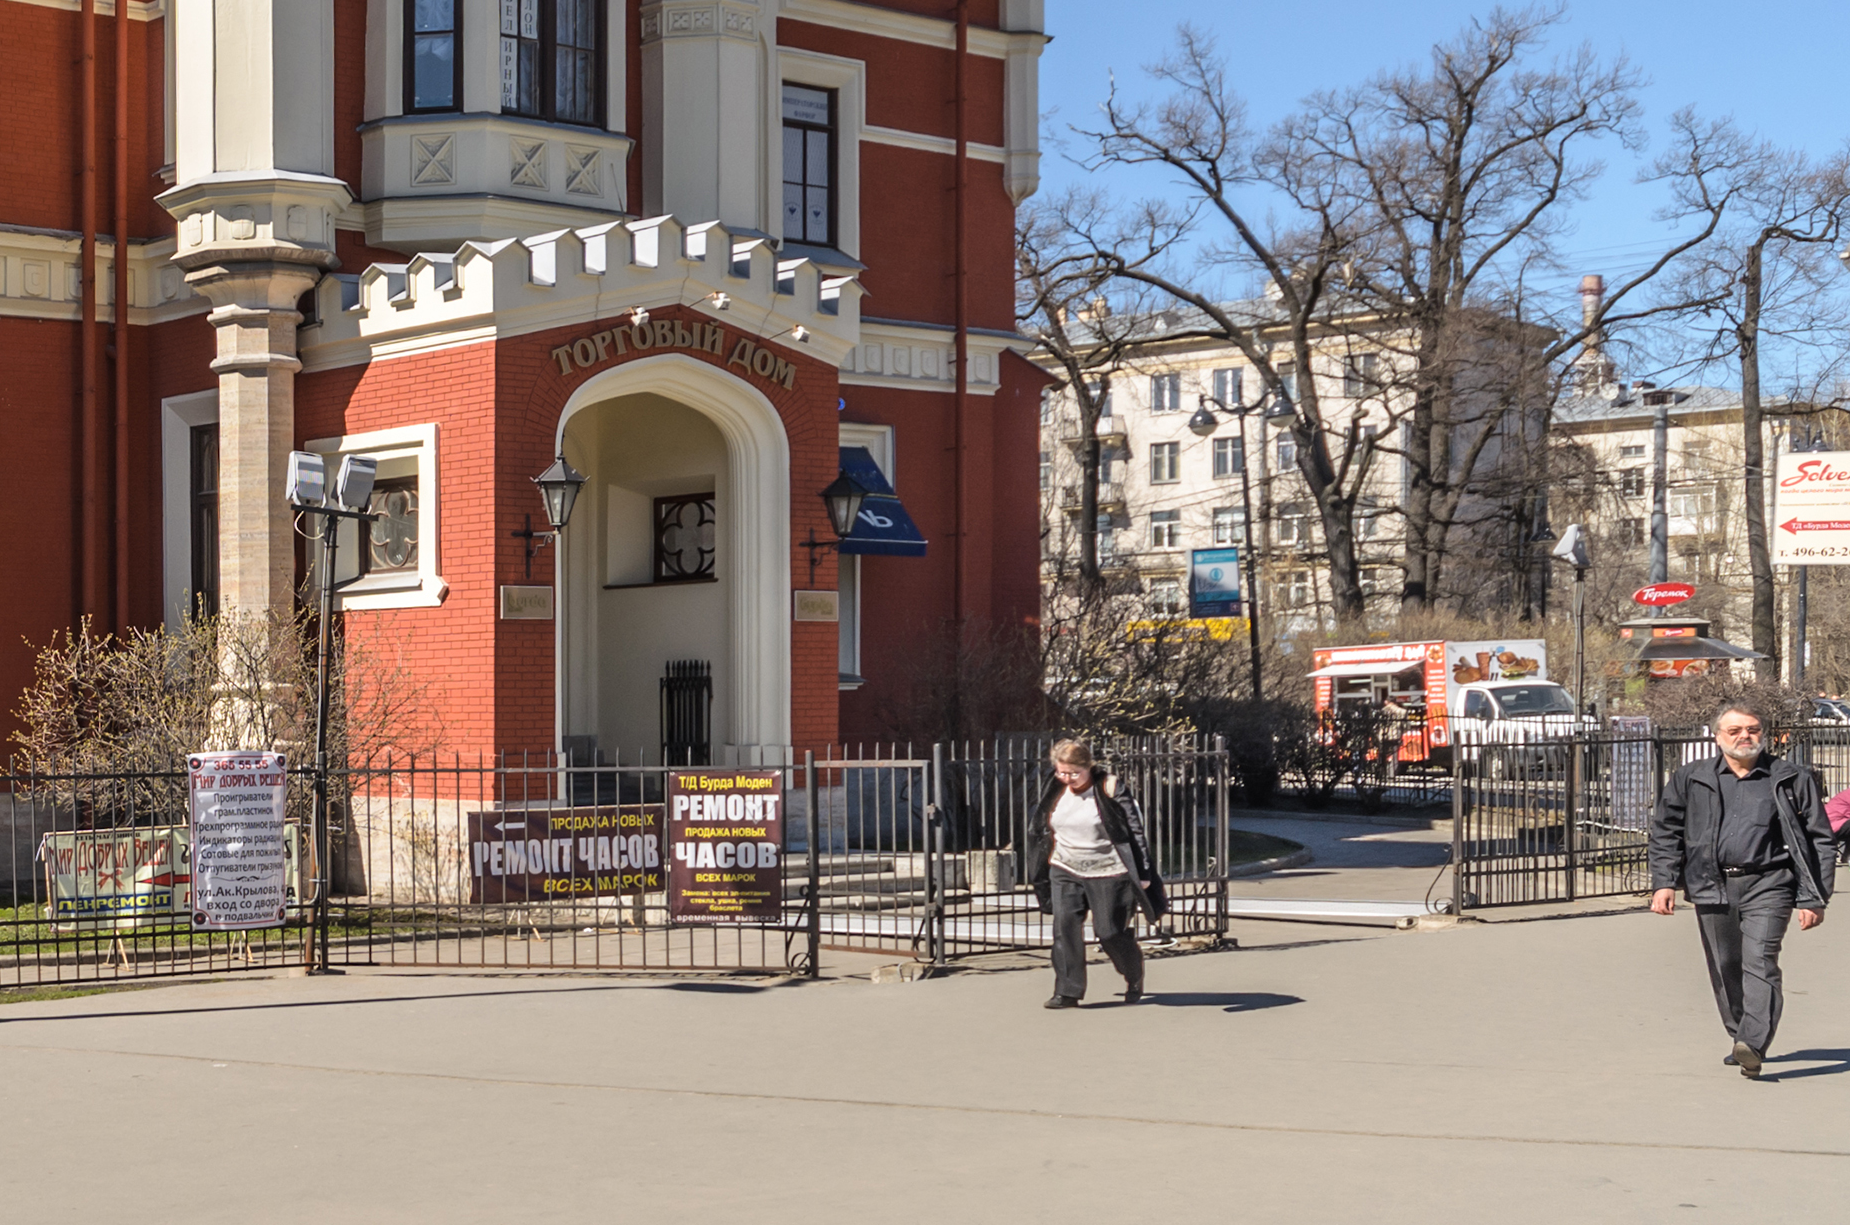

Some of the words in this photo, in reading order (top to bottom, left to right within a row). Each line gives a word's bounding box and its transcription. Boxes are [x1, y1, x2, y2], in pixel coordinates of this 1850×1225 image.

[552, 319, 725, 376] ТОРГОВЫЙ
[727, 337, 798, 391] ДОМ
[1780, 460, 1850, 487] Solve
[1643, 587, 1689, 602] Теремок
[213, 760, 236, 771] 365
[238, 760, 252, 770] 55
[255, 759, 269, 770] 55
[678, 775, 698, 791] Т/Д
[699, 775, 734, 792] Бурда
[736, 775, 773, 790] Моден
[672, 794, 780, 821] РЕМОНТ
[551, 817, 610, 832] ПРОДАЖА
[611, 814, 655, 828] НОВЫХ
[685, 827, 731, 838] ПРОДАЖА
[732, 827, 767, 837] НОВЫХ
[240, 848, 255, 860] для
[473, 838, 573, 877] РЕМОНТ
[578, 834, 660, 872] ЧАСОВ
[675, 841, 778, 869] ЧАСОВ
[543, 877, 594, 894] ВСЕХ
[598, 873, 658, 891] МАРОК
[695, 873, 722, 882] ВСЕХ
[722, 873, 757, 882] МАРОК
[58, 893, 170, 912] ЛЕНРЕМОНТ
[206, 901, 238, 911] вход
[239, 900, 252, 909] со
[253, 898, 280, 911] двора
[676, 914, 730, 923] временная
